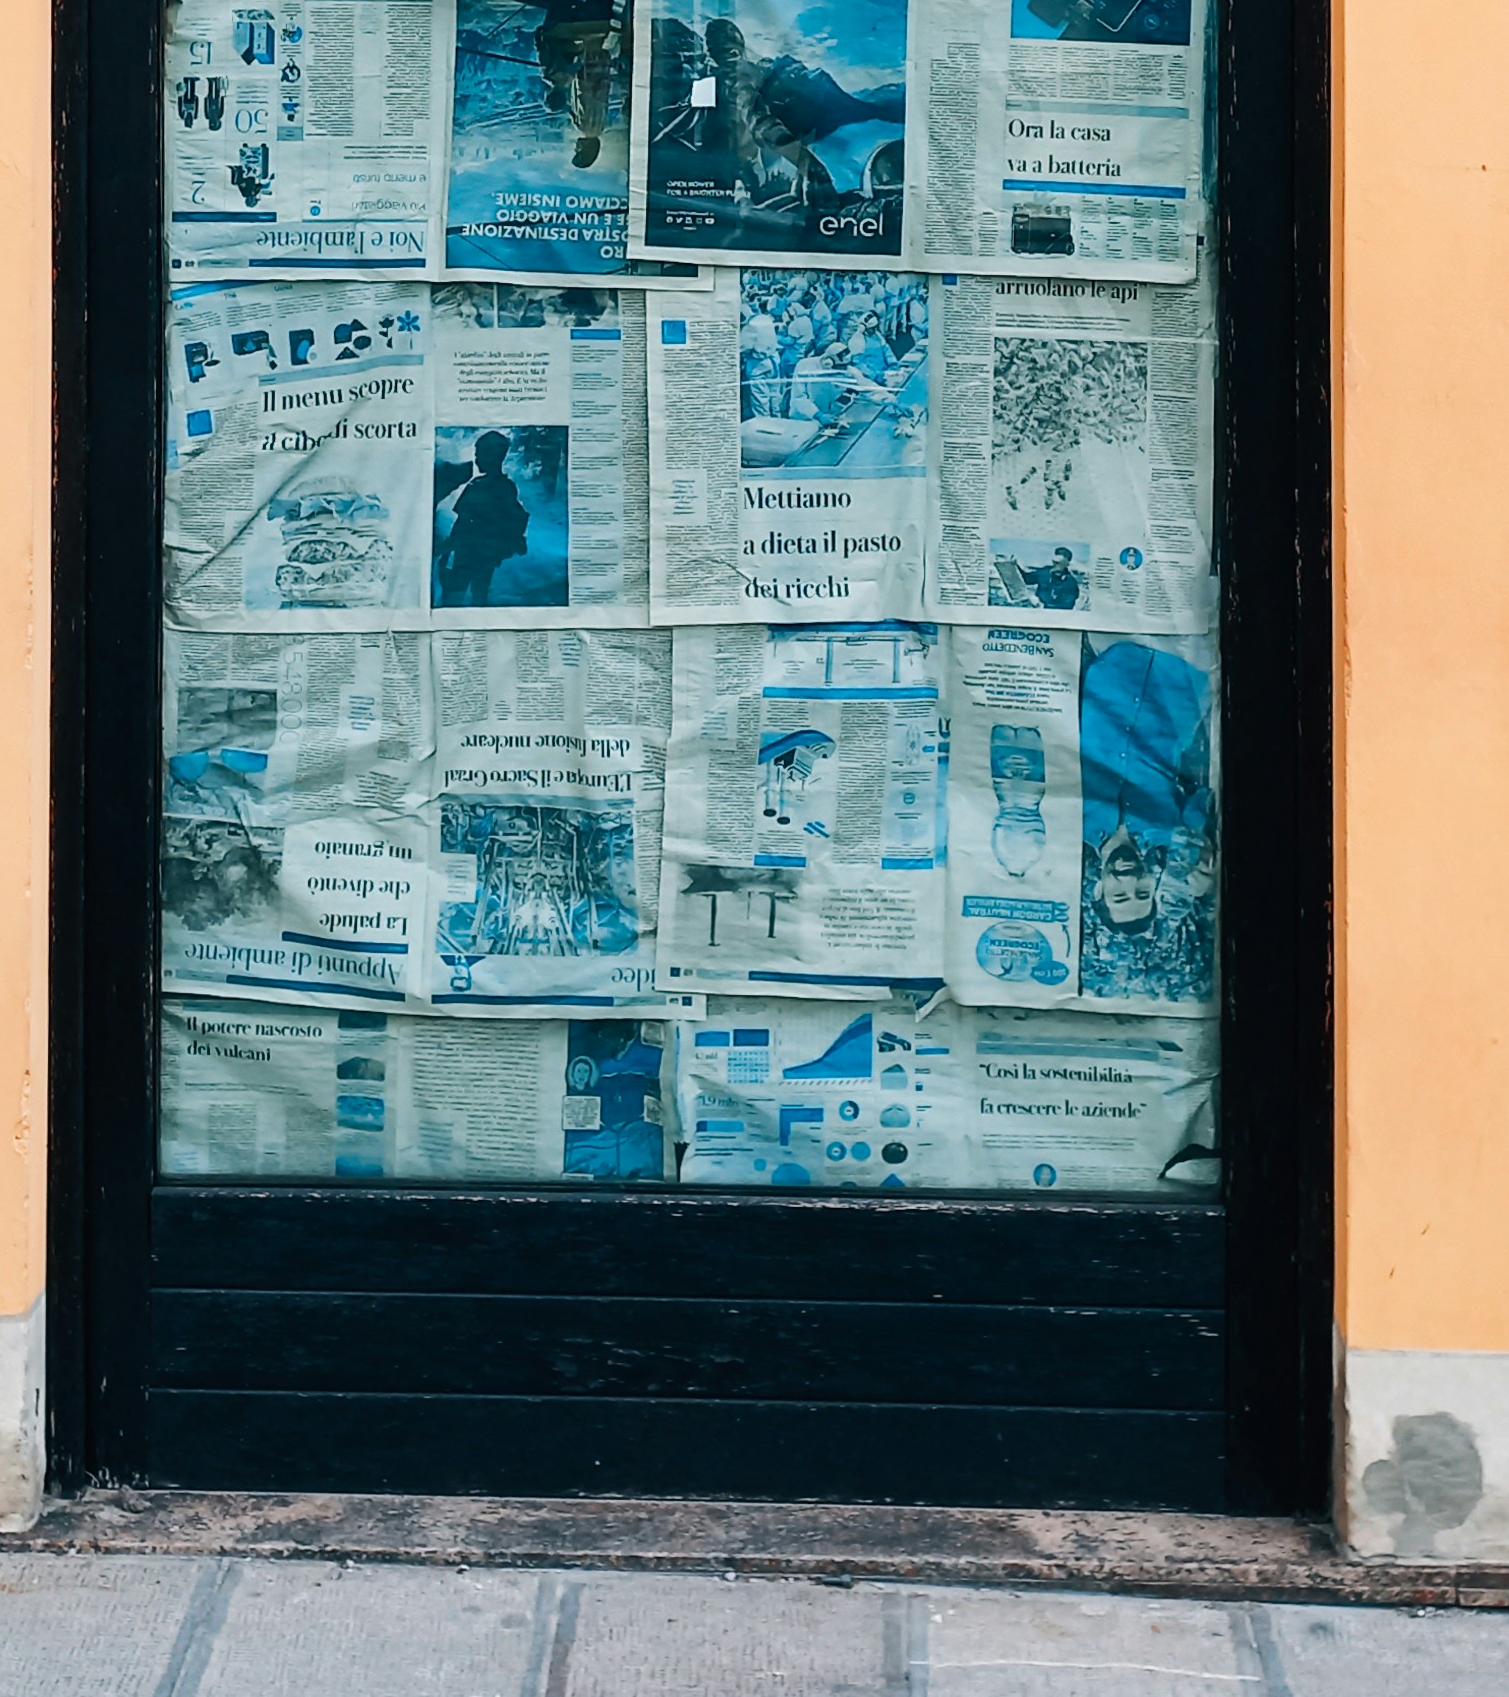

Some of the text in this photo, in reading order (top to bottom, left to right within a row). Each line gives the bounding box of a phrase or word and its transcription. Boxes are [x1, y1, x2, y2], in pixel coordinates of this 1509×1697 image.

[234, 108, 269, 134] 50
[1008, 119, 1111, 142] Ora la casa
[1007, 158, 1121, 178] va a batteria
[190, 180, 206, 205] 2
[492, 193, 561, 208] INSIEME.
[496, 209, 598, 224] UN VIAGGIO
[820, 212, 884, 237] enel
[257, 230, 424, 254] Noi e l'ambiente
[461, 224, 578, 240] DESTINAZIONE
[995, 279, 1086, 298] arruolano
[1091, 281, 1106, 298] le
[263, 376, 414, 413] Il menu scopre
[262, 433, 276, 451] il
[353, 419, 417, 440] scorta
[744, 487, 851, 510] Mettiamo
[744, 530, 901, 558] a dieta il pasto
[744, 576, 850, 599] dei ricchi
[988, 630, 1050, 644] ECOGREEN
[460, 735, 630, 757] della fusione nucleare
[443, 769, 632, 792] L'Europa e il Sacro Graal
[314, 840, 412, 860] un granaio
[307, 877, 410, 900] che diventò
[319, 911, 408, 935] La palude
[184, 943, 404, 985] Appunti di ambiente
[186, 1016, 322, 1038] Il potere nascosto
[187, 1041, 271, 1061] dei vulcani
[1023, 1064, 1036, 1080] la
[1040, 1066, 1133, 1084] sostenibilità
[980, 1098, 992, 1115] fa
[997, 1104, 1062, 1115] crescere
[1065, 1100, 1078, 1117] le
